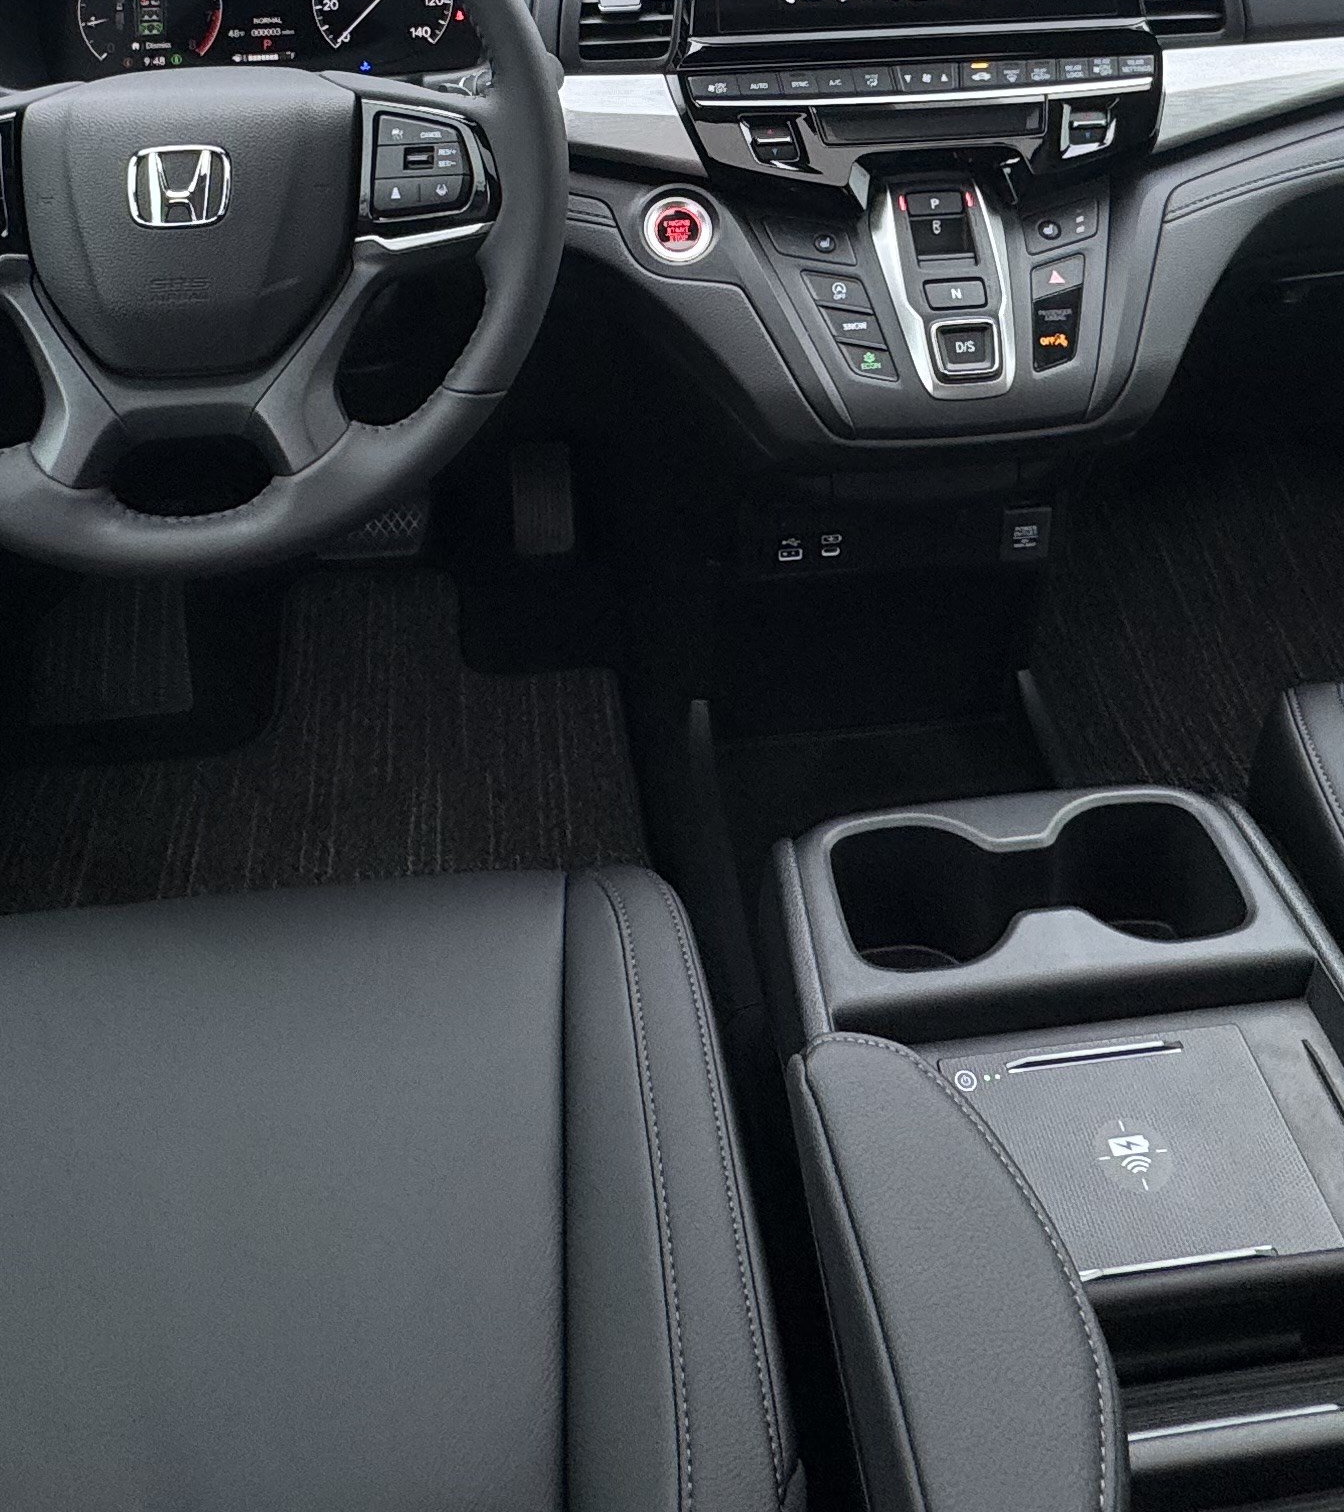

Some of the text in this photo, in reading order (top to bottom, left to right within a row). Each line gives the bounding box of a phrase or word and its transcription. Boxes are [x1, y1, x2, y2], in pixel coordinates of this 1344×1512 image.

[323, 0, 339, 11] 20
[409, 26, 432, 39] 140
[263, 39, 272, 50] P
[143, 56, 166, 66] 9:48
[749, 82, 769, 90] AUTO
[929, 198, 940, 210] P
[950, 288, 962, 300] N
[842, 321, 867, 332] SNOW
[955, 340, 976, 354] D/S
[860, 362, 882, 370] ECON
